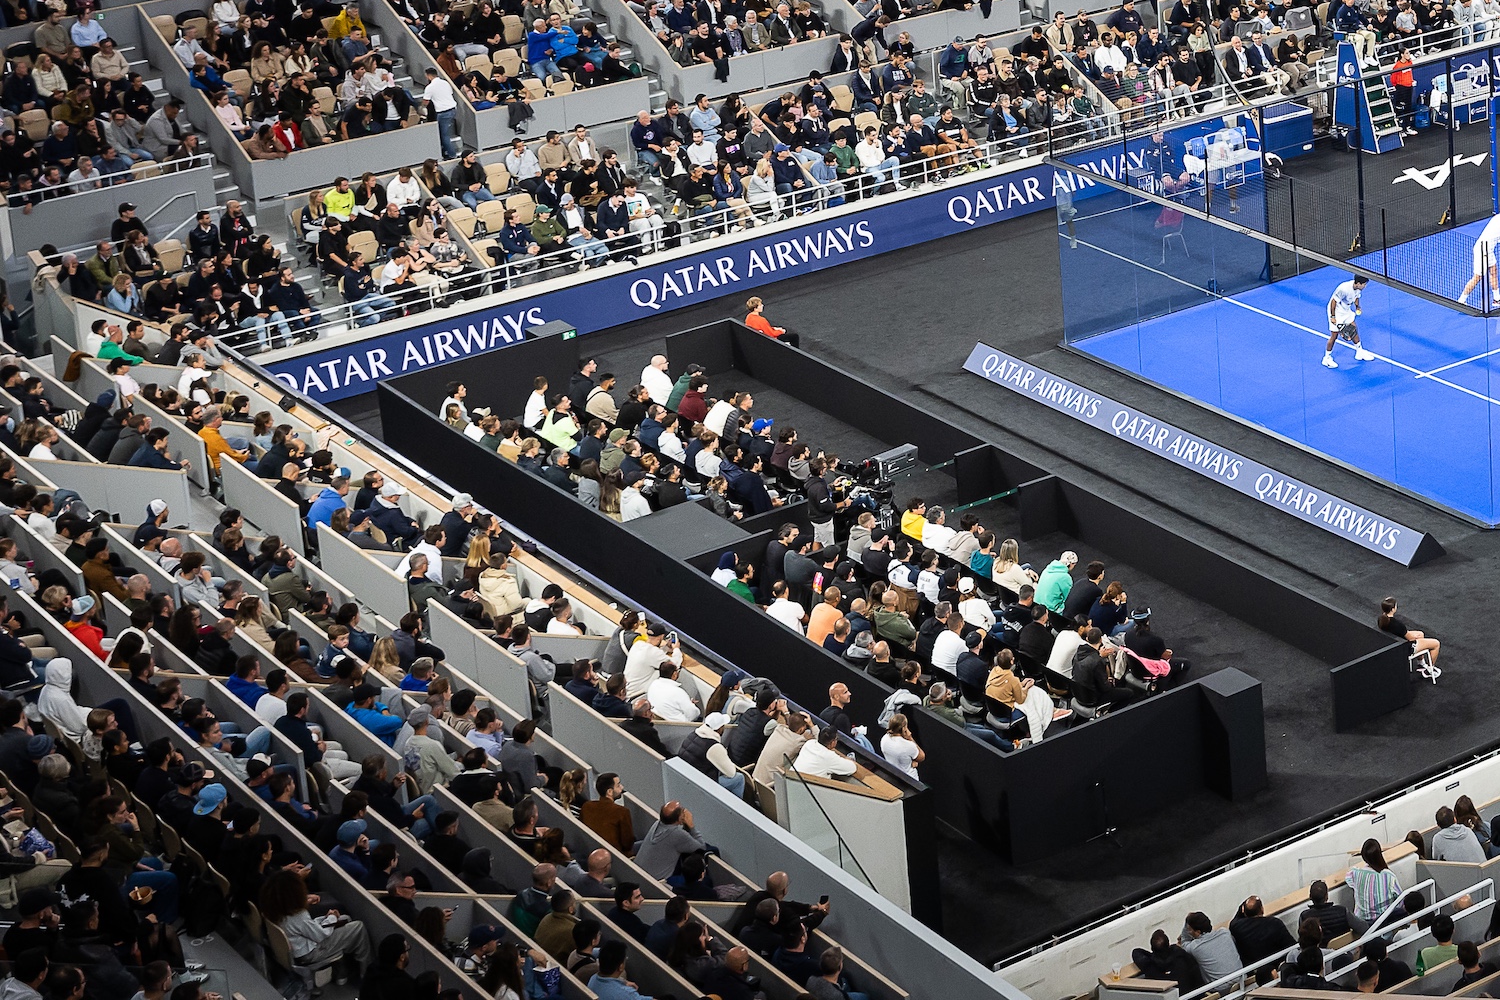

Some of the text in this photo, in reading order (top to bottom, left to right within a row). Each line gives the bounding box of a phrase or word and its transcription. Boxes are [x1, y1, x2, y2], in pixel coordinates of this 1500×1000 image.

[947, 148, 1146, 226] QATAR AIRWAY
[630, 220, 875, 310] QATAR AIRWAYS
[401, 307, 546, 372] AIRWAYS
[982, 353, 1102, 419] QATAR AIRWAYS
[1111, 410, 1244, 481] QATAR AIRWAYS
[1254, 472, 1401, 550] QATAR AIRWAYS
